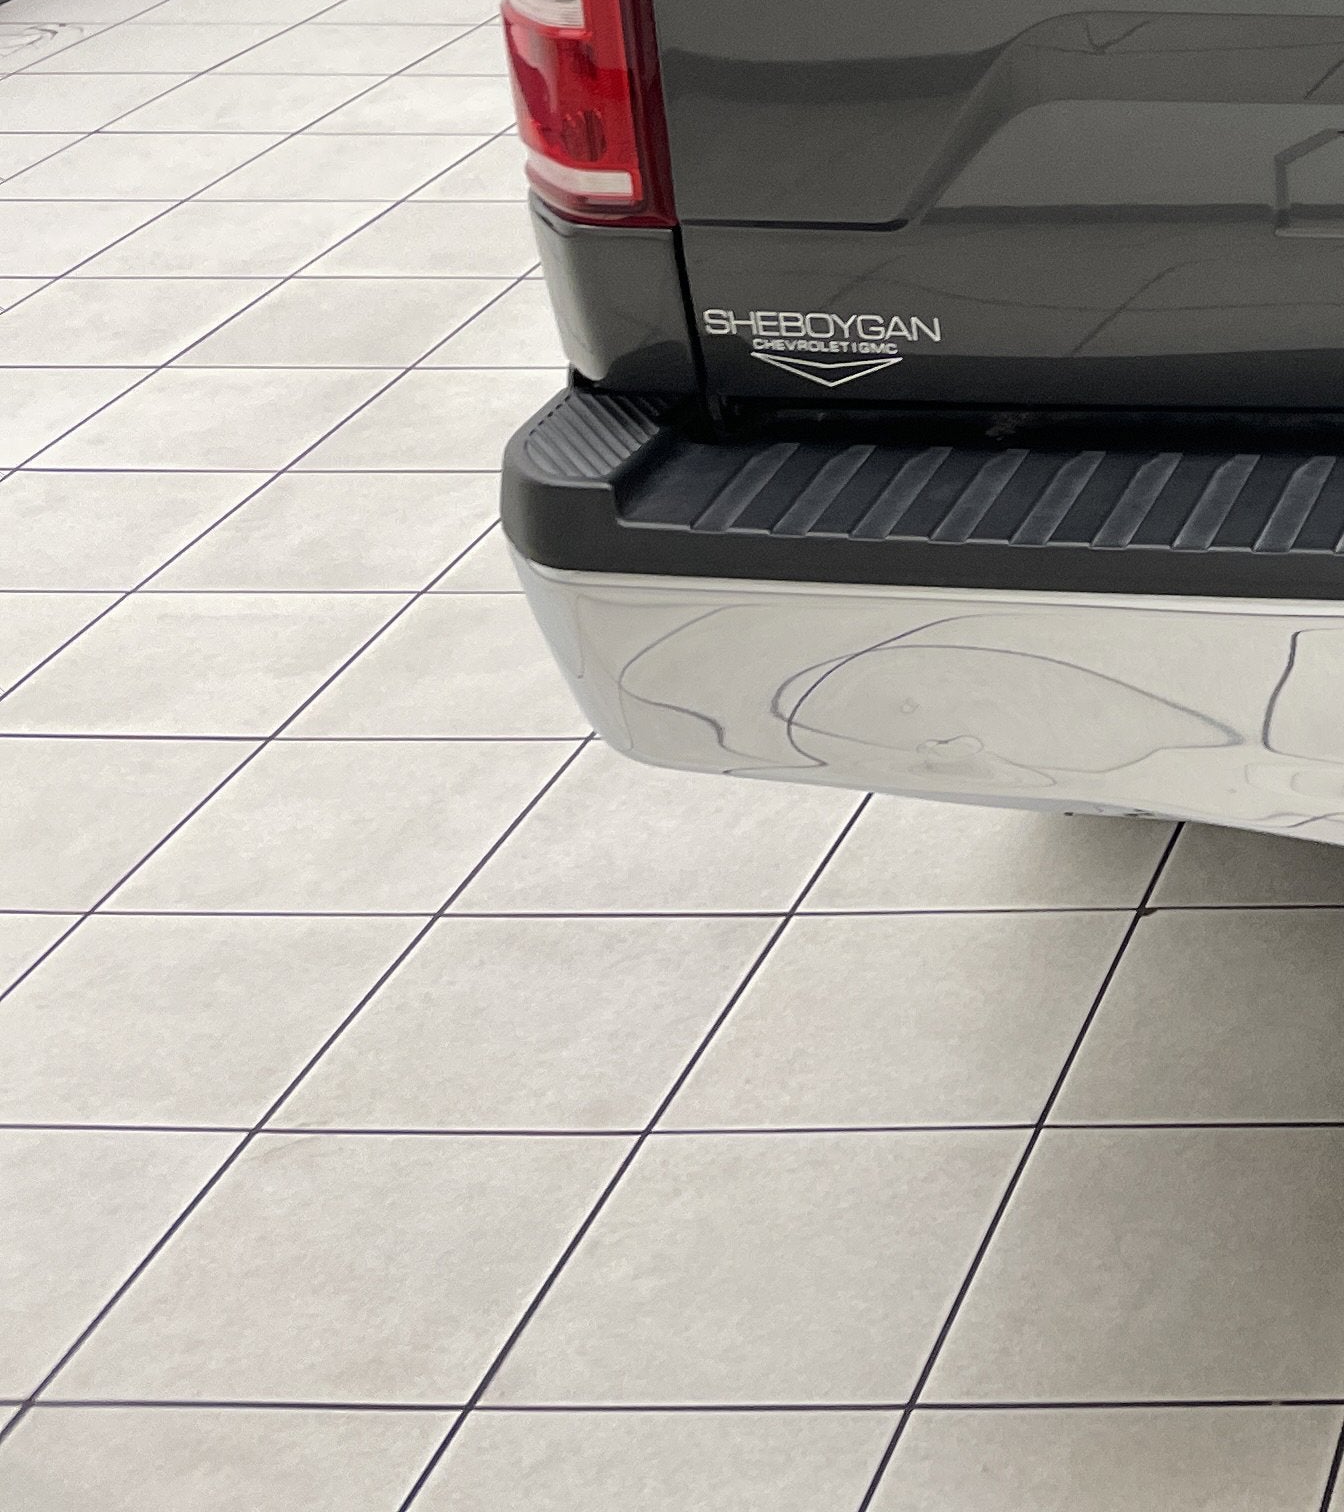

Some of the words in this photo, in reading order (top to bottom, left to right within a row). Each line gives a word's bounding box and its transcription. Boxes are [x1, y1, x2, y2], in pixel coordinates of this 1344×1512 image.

[703, 309, 942, 342] SHEBOYGAN
[752, 338, 850, 353] CHEVROLET
[858, 342, 898, 355] GMC
